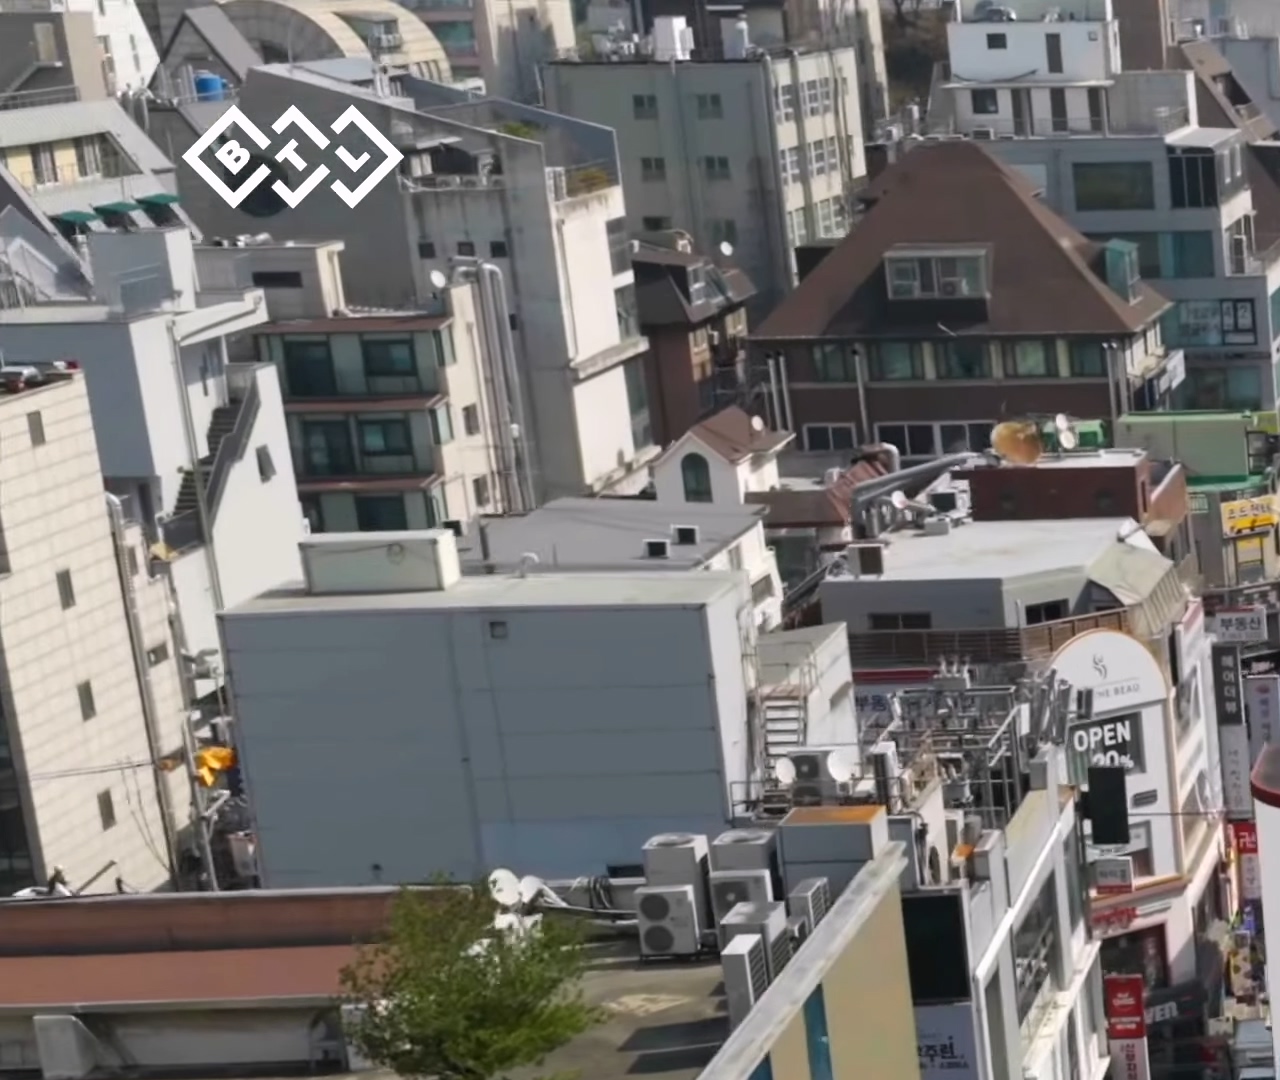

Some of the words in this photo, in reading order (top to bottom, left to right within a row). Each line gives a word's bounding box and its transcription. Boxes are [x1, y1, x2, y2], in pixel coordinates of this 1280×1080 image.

[1220, 616, 1261, 631] 부동산
[1221, 655, 1238, 714] 헤어더뷰
[1073, 720, 1131, 752] OPEN
